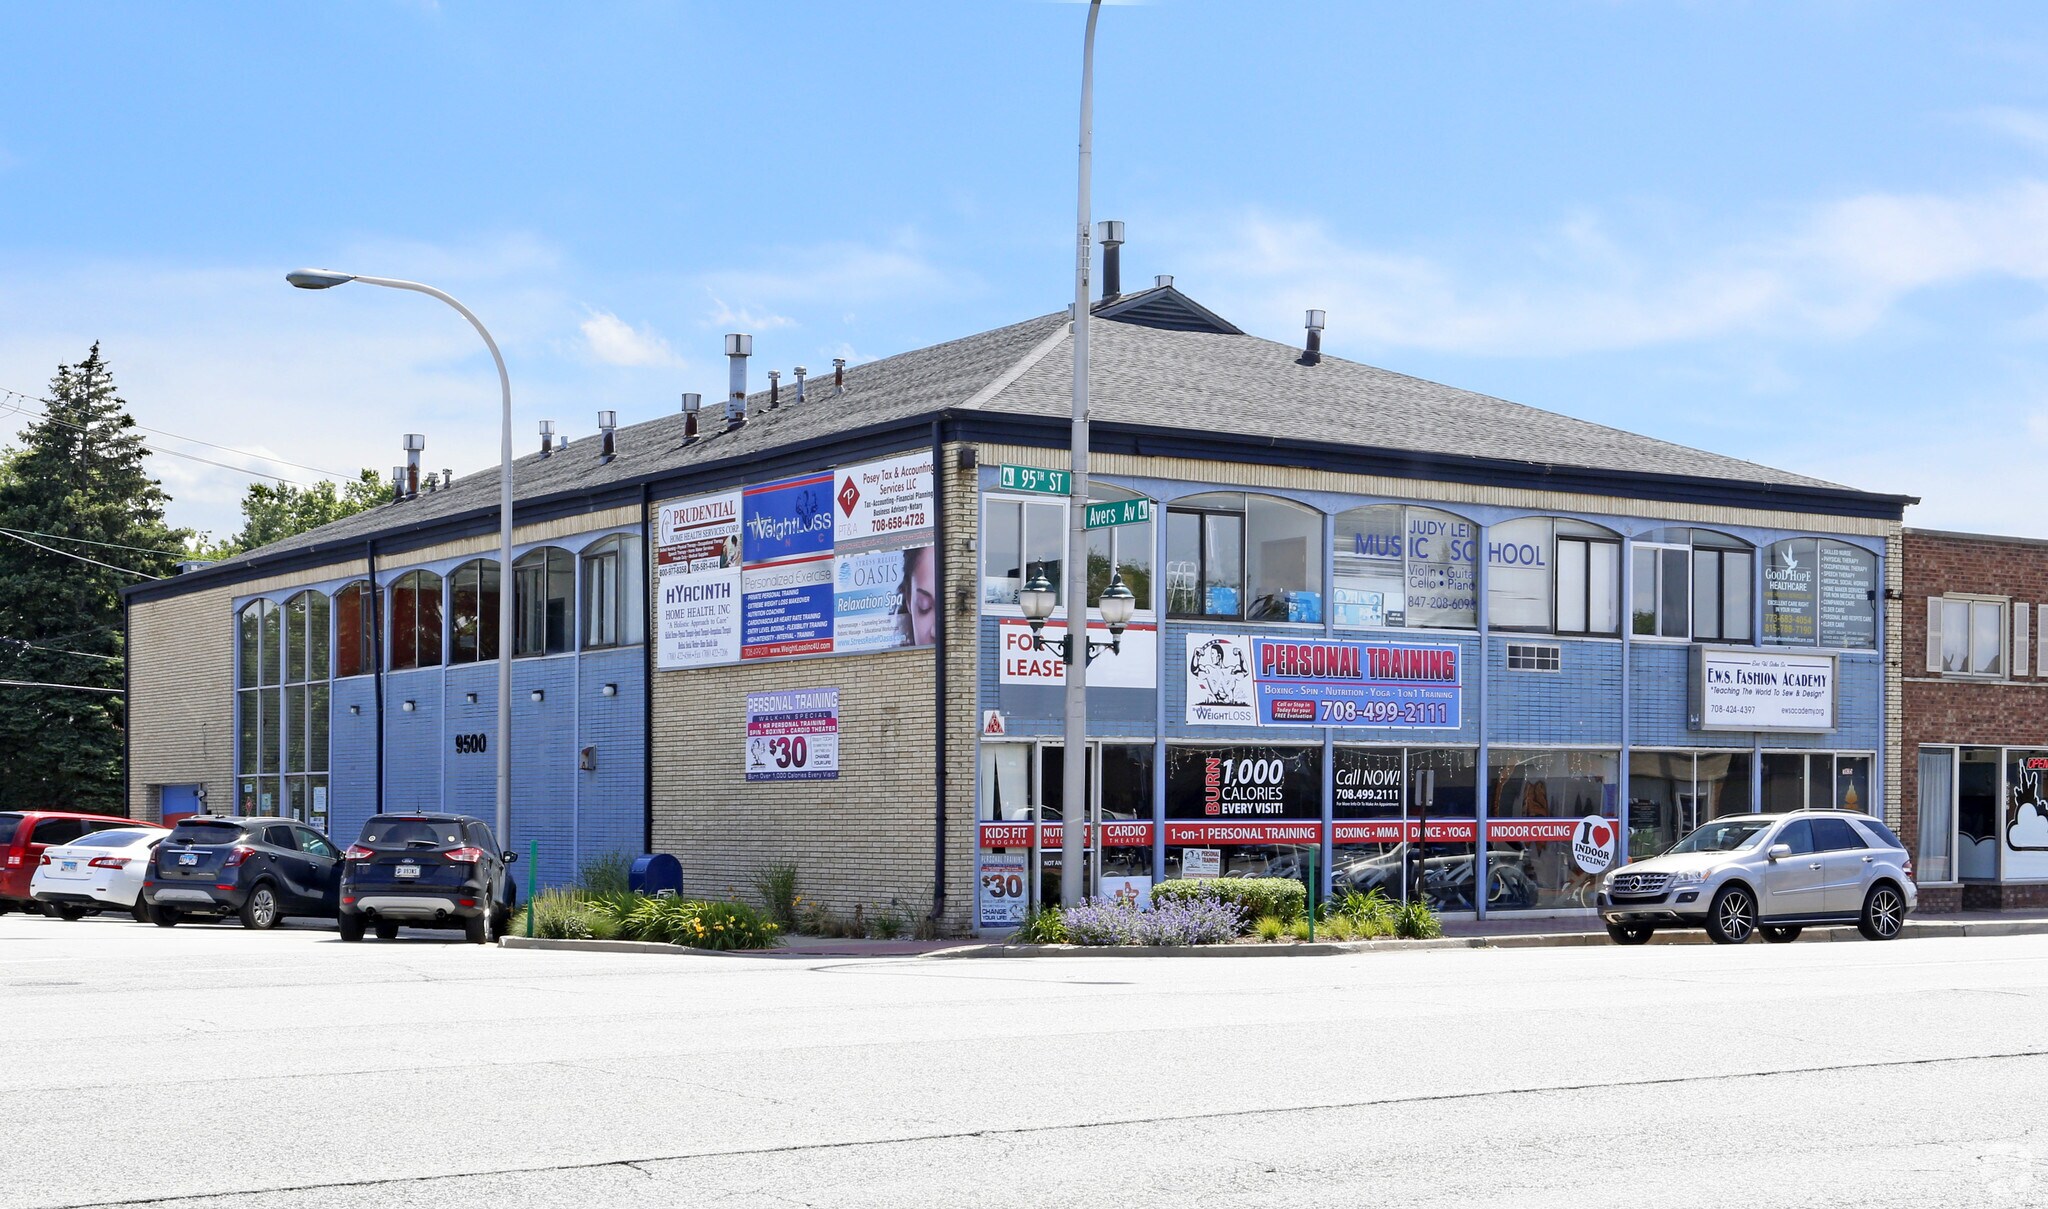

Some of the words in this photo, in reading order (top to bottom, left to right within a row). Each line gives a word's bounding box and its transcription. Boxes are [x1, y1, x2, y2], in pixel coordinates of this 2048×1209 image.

[863, 473, 881, 486] Posey
[882, 469, 893, 481] Tax
[894, 467, 900, 479] &
[901, 461, 935, 478] Accounting
[1022, 469, 1044, 489] 95TH
[1049, 473, 1063, 492] ST
[880, 482, 904, 496] Services
[906, 478, 917, 492] LLC
[674, 500, 736, 525] PRUDENTIAL
[1090, 507, 1116, 526] Avers
[1123, 502, 1135, 519] Av
[670, 532, 684, 544] HOME
[684, 529, 702, 542] HEALTH
[703, 526, 725, 538] SERVICES
[1410, 519, 1446, 536] JUDY
[1451, 523, 1470, 538] LEI
[1355, 533, 1428, 558] MUSIC
[856, 558, 874, 568] STRESS
[877, 556, 898, 564] RELIEF
[854, 564, 898, 586] OASIS
[1408, 563, 1436, 576] Violin
[1447, 567, 1474, 580] Guita
[745, 573, 794, 591] Personalized
[796, 570, 832, 584] Exercise
[1448, 580, 1476, 591] Piano
[1770, 581, 1808, 592] HEALTHCARE
[666, 582, 730, 604] HYACINTH
[762, 591, 781, 600] PERSONAL
[782, 588, 799, 598] TRAINING
[838, 594, 883, 613] Relaxation
[884, 590, 904, 608] Spa
[764, 600, 778, 608] WEIGHT
[789, 596, 810, 604] MAKEOVER
[666, 608, 685, 620] HOME
[718, 604, 731, 615] INC
[748, 616, 780, 626] CARDIOVASCULAR
[780, 616, 792, 624] HEART
[804, 612, 821, 621] TRAINING
[766, 608, 786, 616] COACHING
[787, 622, 808, 631] FLEXIBILITY
[809, 620, 828, 629] TRAINING
[796, 630, 815, 639] TRAINING
[1007, 658, 1064, 678] LEASE
[1261, 642, 1362, 680] PERSONAL
[1367, 646, 1456, 682] TRAINING
[1708, 668, 1733, 685] E.W.S.
[1736, 669, 1778, 686] FASHION
[1783, 672, 1828, 688] ACADEMY
[1742, 688, 1752, 696] The
[1755, 688, 1771, 697] World
[748, 696, 793, 712] PERSONAL
[795, 692, 838, 710] TRAINING
[1711, 704, 1756, 714] 708-424-4397
[1782, 706, 1825, 716] ewsacademy.org
[1321, 700, 1447, 724] 708-499-2111
[800, 720, 826, 728] TRAINING
[456, 734, 486, 754] 9500
[769, 736, 808, 768] $30
[1222, 759, 1284, 786] 1,000
[1336, 770, 1360, 786] Call
[1362, 770, 1402, 786] NOW!
[1206, 758, 1220, 816] BURN
[1222, 786, 1284, 801] CALORIES
[1336, 790, 1400, 800] 708.499.2111
[1222, 802, 1255, 814] EVERY
[1256, 803, 1284, 814] VISIT!
[984, 828, 1010, 839] KIDS
[1012, 827, 1028, 838] FIT
[1107, 826, 1146, 837] CARDIO
[1171, 828, 1204, 840] 1-on-1
[1208, 828, 1263, 840] PERSONAL
[1266, 828, 1316, 839] TRAINING
[1336, 828, 1370, 838] BOXING
[1376, 828, 1399, 838] MMA
[1447, 826, 1472, 838] YOGA
[1491, 826, 1529, 838] INDOOR
[1530, 825, 1570, 837] CYCLING
[1581, 822, 1592, 844] I
[1574, 843, 1610, 860] INDOOR
[1576, 854, 1606, 867] CYCLING
[982, 874, 1023, 898] $30
